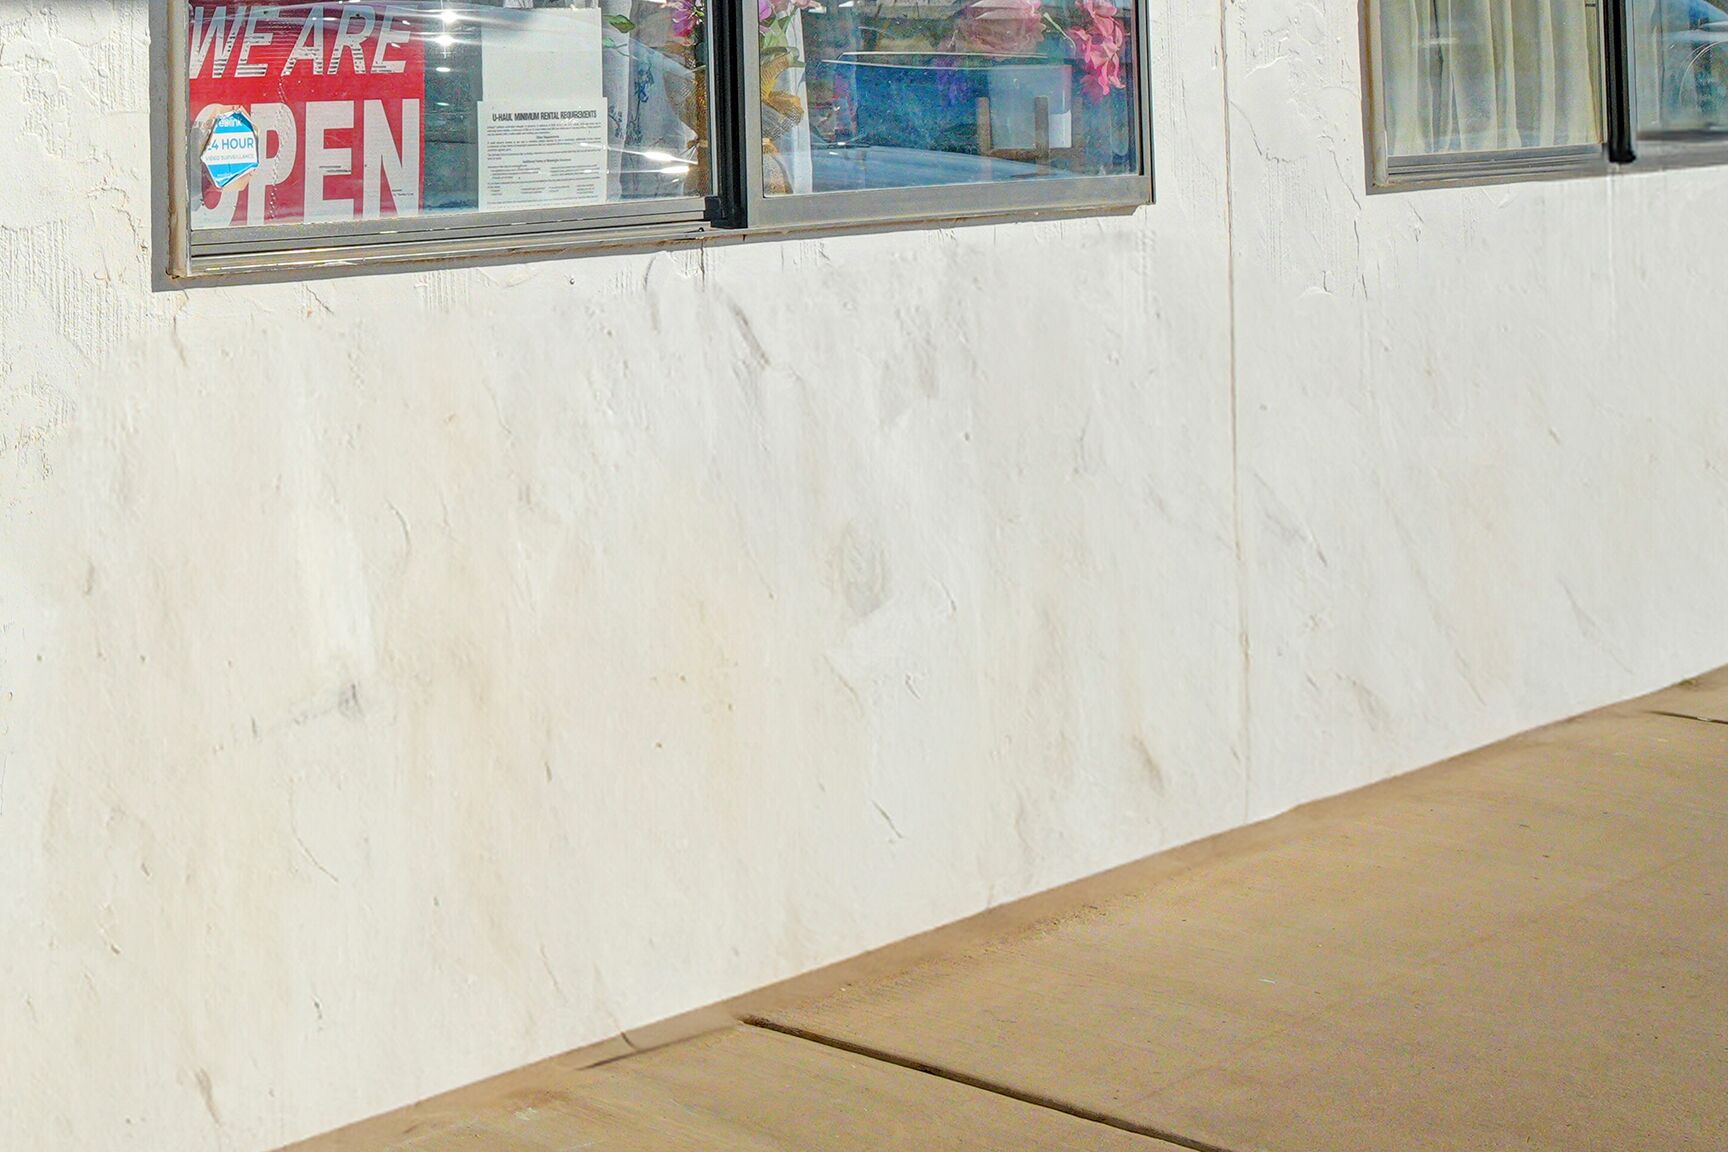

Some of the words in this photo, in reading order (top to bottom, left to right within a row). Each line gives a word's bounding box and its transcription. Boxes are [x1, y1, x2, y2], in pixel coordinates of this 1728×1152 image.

[189, 5, 282, 79] WE
[281, 5, 419, 77] ARE
[492, 113, 513, 122] U-HAUL
[514, 112, 539, 121] MINIMUM
[540, 111, 560, 120] RENTAL
[222, 138, 255, 150] HOUR
